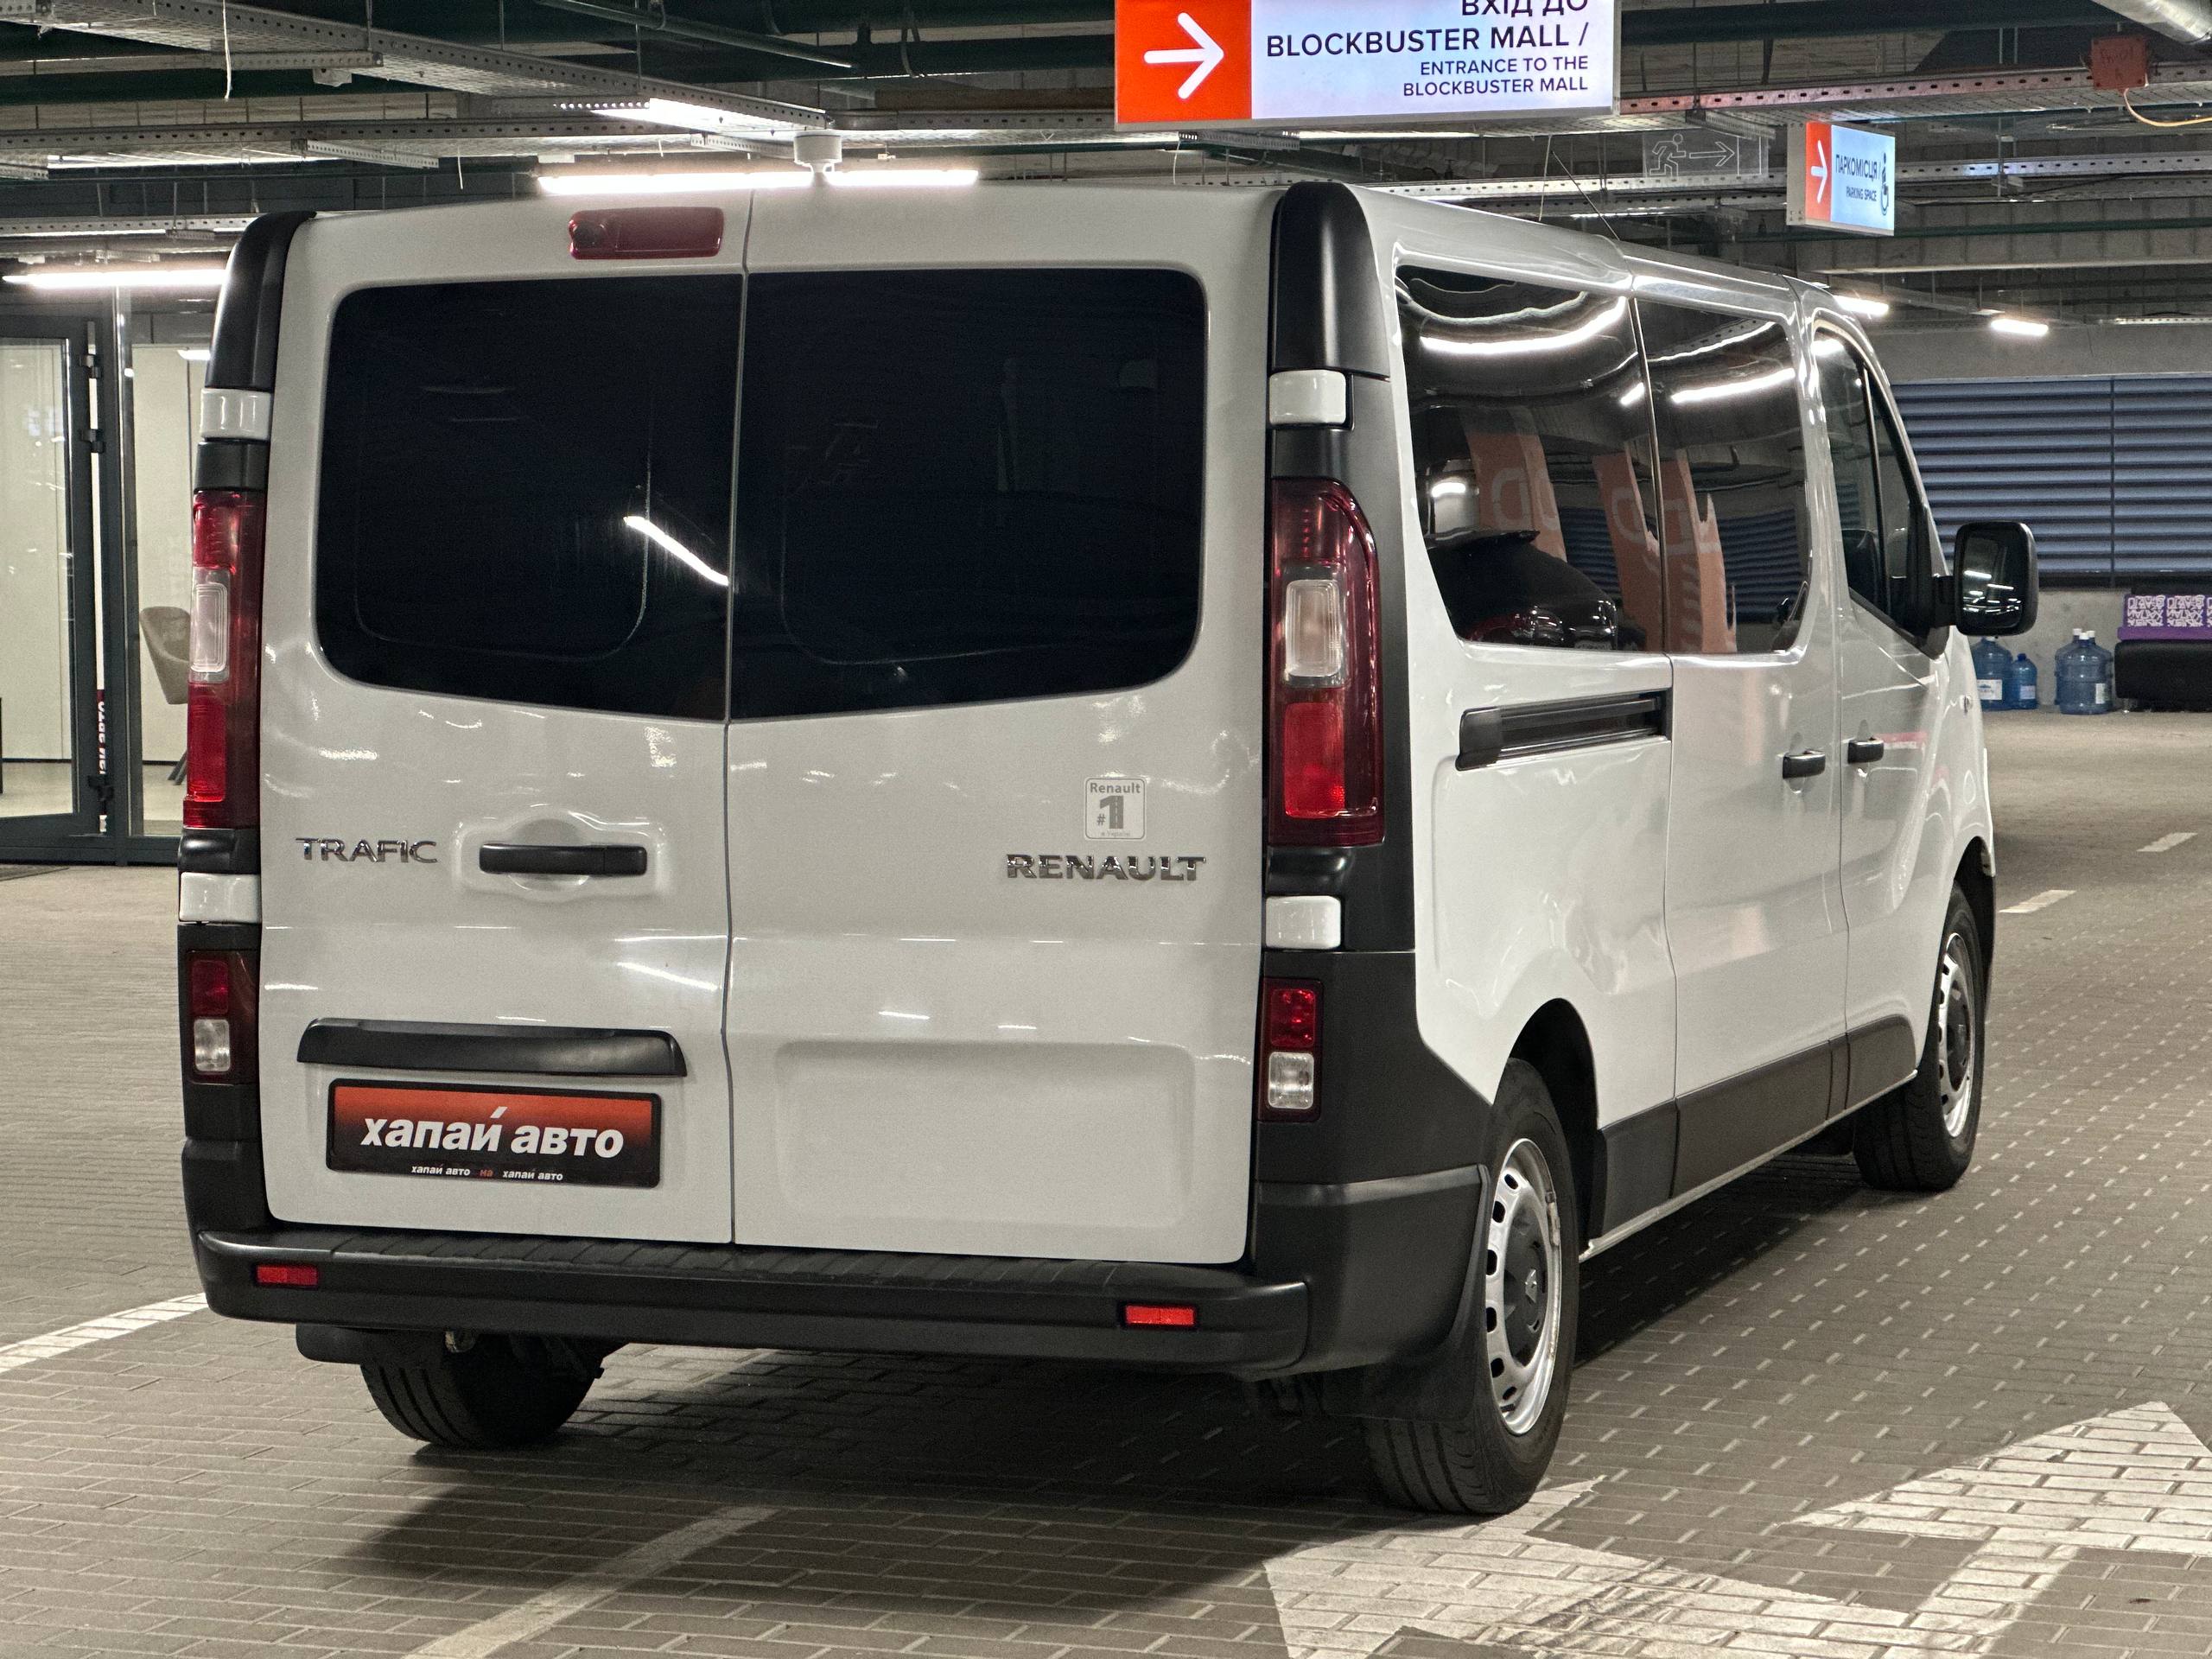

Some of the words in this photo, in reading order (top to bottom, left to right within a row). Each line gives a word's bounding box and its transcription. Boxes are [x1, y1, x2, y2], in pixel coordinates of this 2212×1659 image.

[1462, 0, 1533, 18] ВХІД
[1542, 0, 1588, 16] ДО
[1267, 27, 1480, 57] BLOCKBUSTER
[1491, 24, 1570, 49] MALL
[1420, 58, 1517, 76] ENTRANCE
[1522, 57, 1548, 72] TO
[1553, 55, 1589, 71] THE
[1403, 78, 1535, 97] BLOCKBUSTER
[1540, 76, 1589, 92] MALL
[1846, 186, 1864, 200] PARKING
[1864, 188, 1878, 202] SPACE
[1090, 782, 1141, 794] Renault
[296, 837, 438, 863] TRAFIC
[1007, 854, 1207, 881] RENAULT
[510, 1124, 625, 1159] авто
[445, 1166, 472, 1177] авто
[537, 1172, 564, 1181] авто
